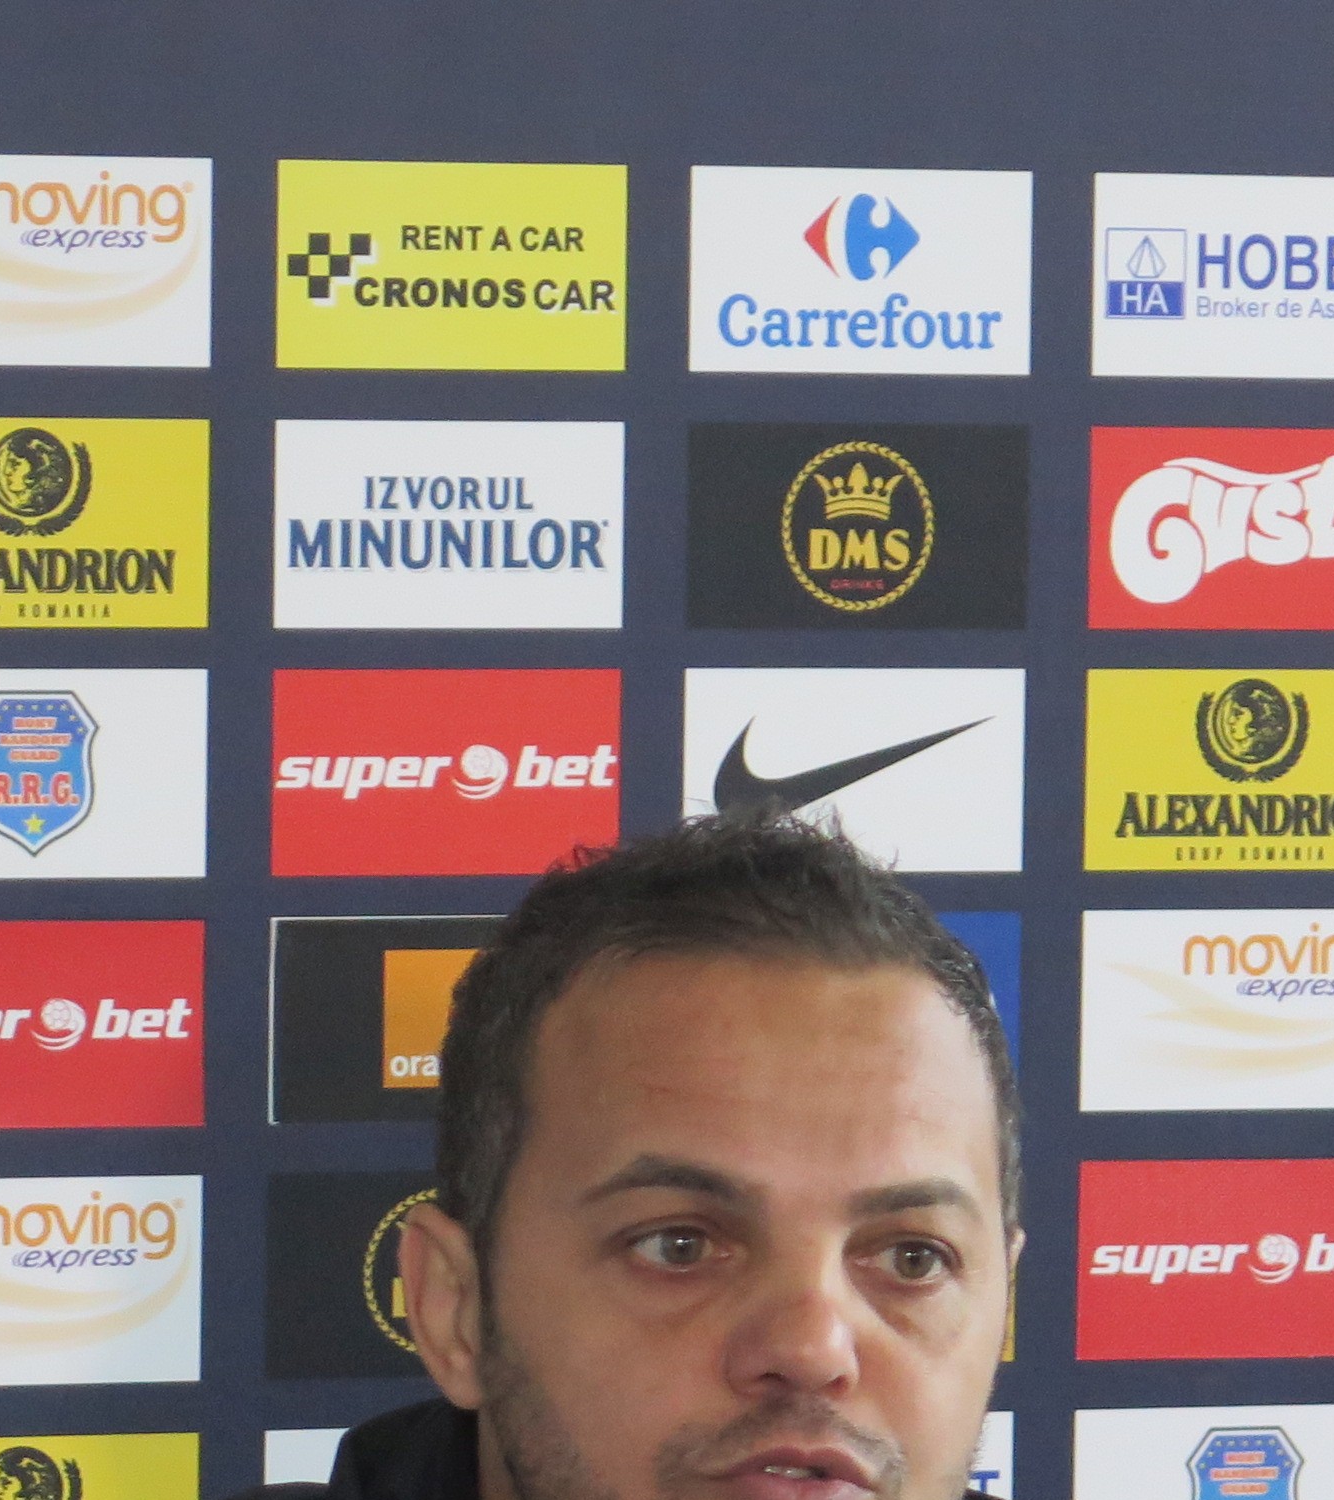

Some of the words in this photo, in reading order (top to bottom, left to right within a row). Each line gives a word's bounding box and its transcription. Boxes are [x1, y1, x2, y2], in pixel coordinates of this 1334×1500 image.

[31, 224, 147, 254] express
[402, 225, 483, 251] RENT
[491, 227, 511, 251] A
[519, 227, 584, 252] CAR
[351, 273, 526, 308] CRONOS
[534, 279, 615, 313] CAR
[1114, 283, 1172, 317] HA
[1196, 295, 1264, 318] Broker
[1275, 298, 1302, 318] de
[718, 293, 1001, 350] Carrefour
[365, 476, 533, 510] IZVORUL
[289, 519, 604, 569] MINUNILOR
[809, 529, 910, 571] DMS
[275, 756, 453, 800] super
[514, 745, 621, 789] bet
[92, 999, 192, 1039] bet
[22, 1244, 138, 1273] express
[1090, 1244, 1248, 1284] super
